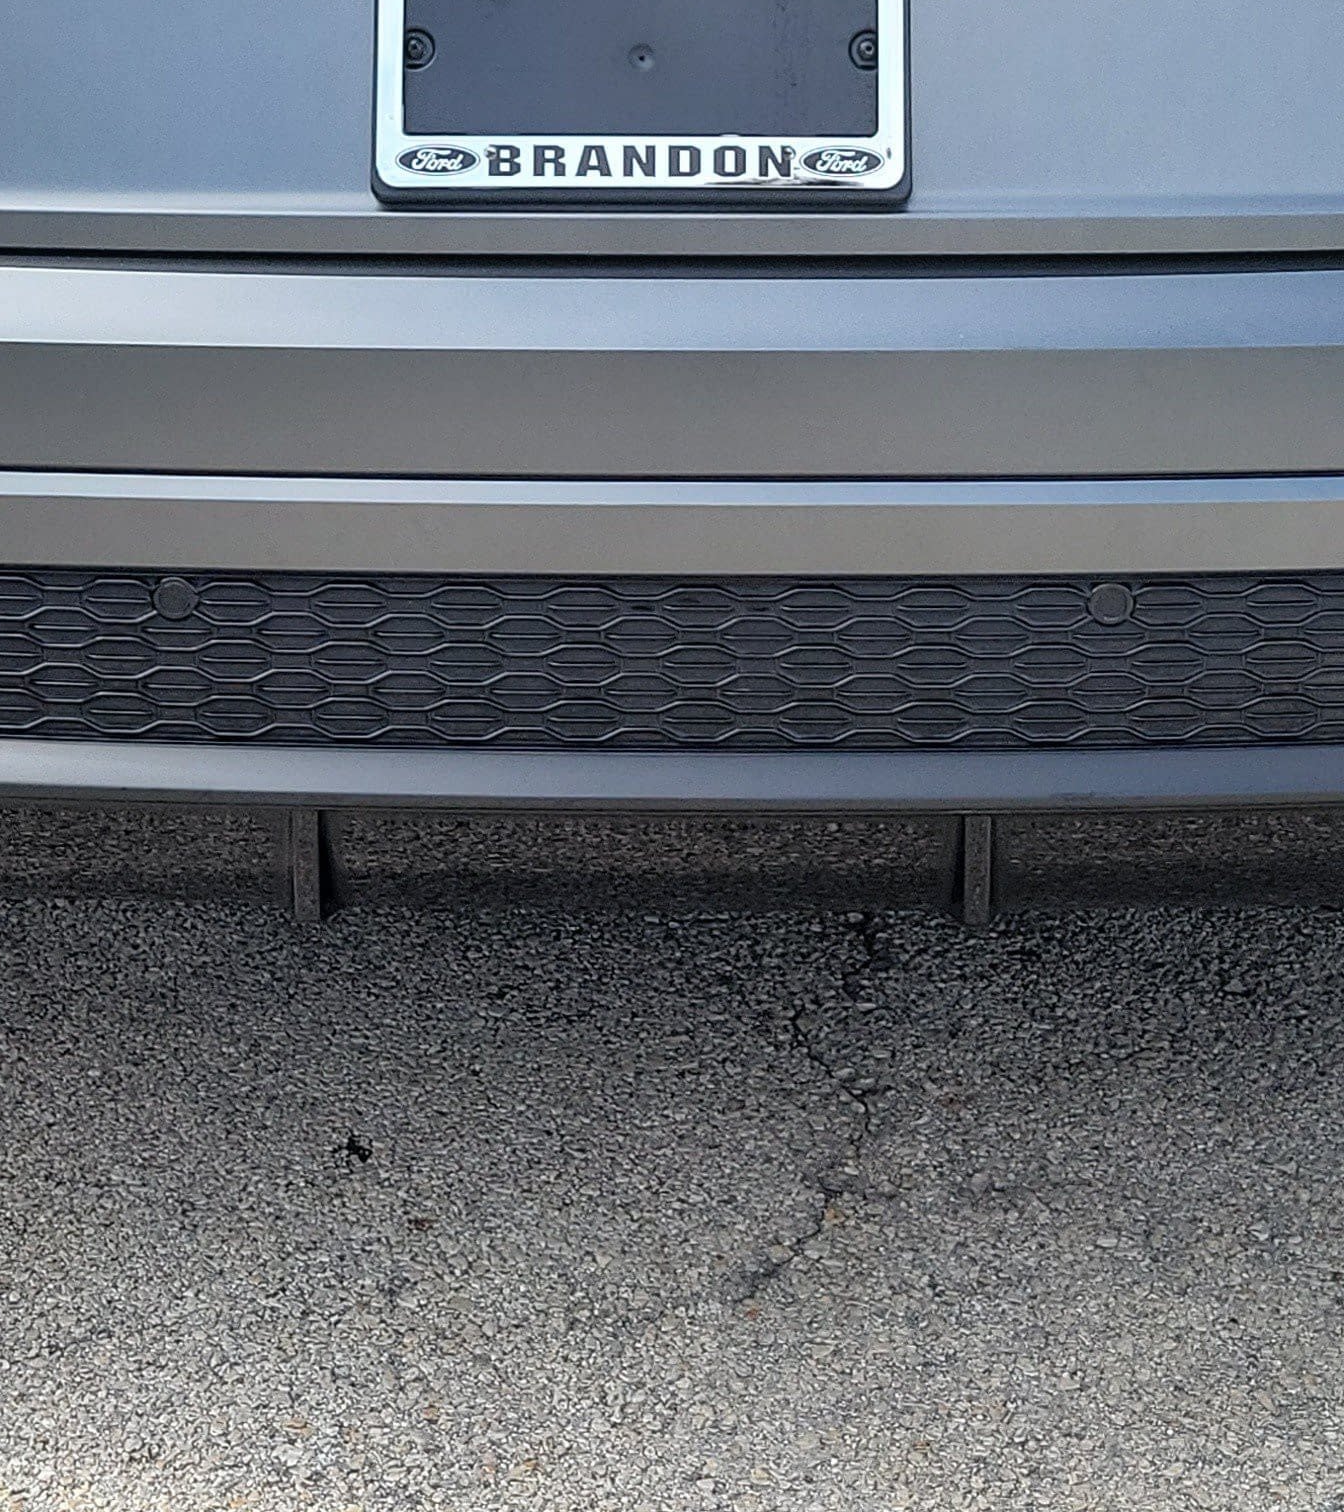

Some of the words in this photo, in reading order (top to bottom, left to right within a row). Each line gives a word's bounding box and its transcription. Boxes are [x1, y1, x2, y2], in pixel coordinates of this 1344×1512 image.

[411, 148, 465, 172] Ford
[488, 144, 793, 178] BRANDON
[814, 150, 869, 174] Ford
